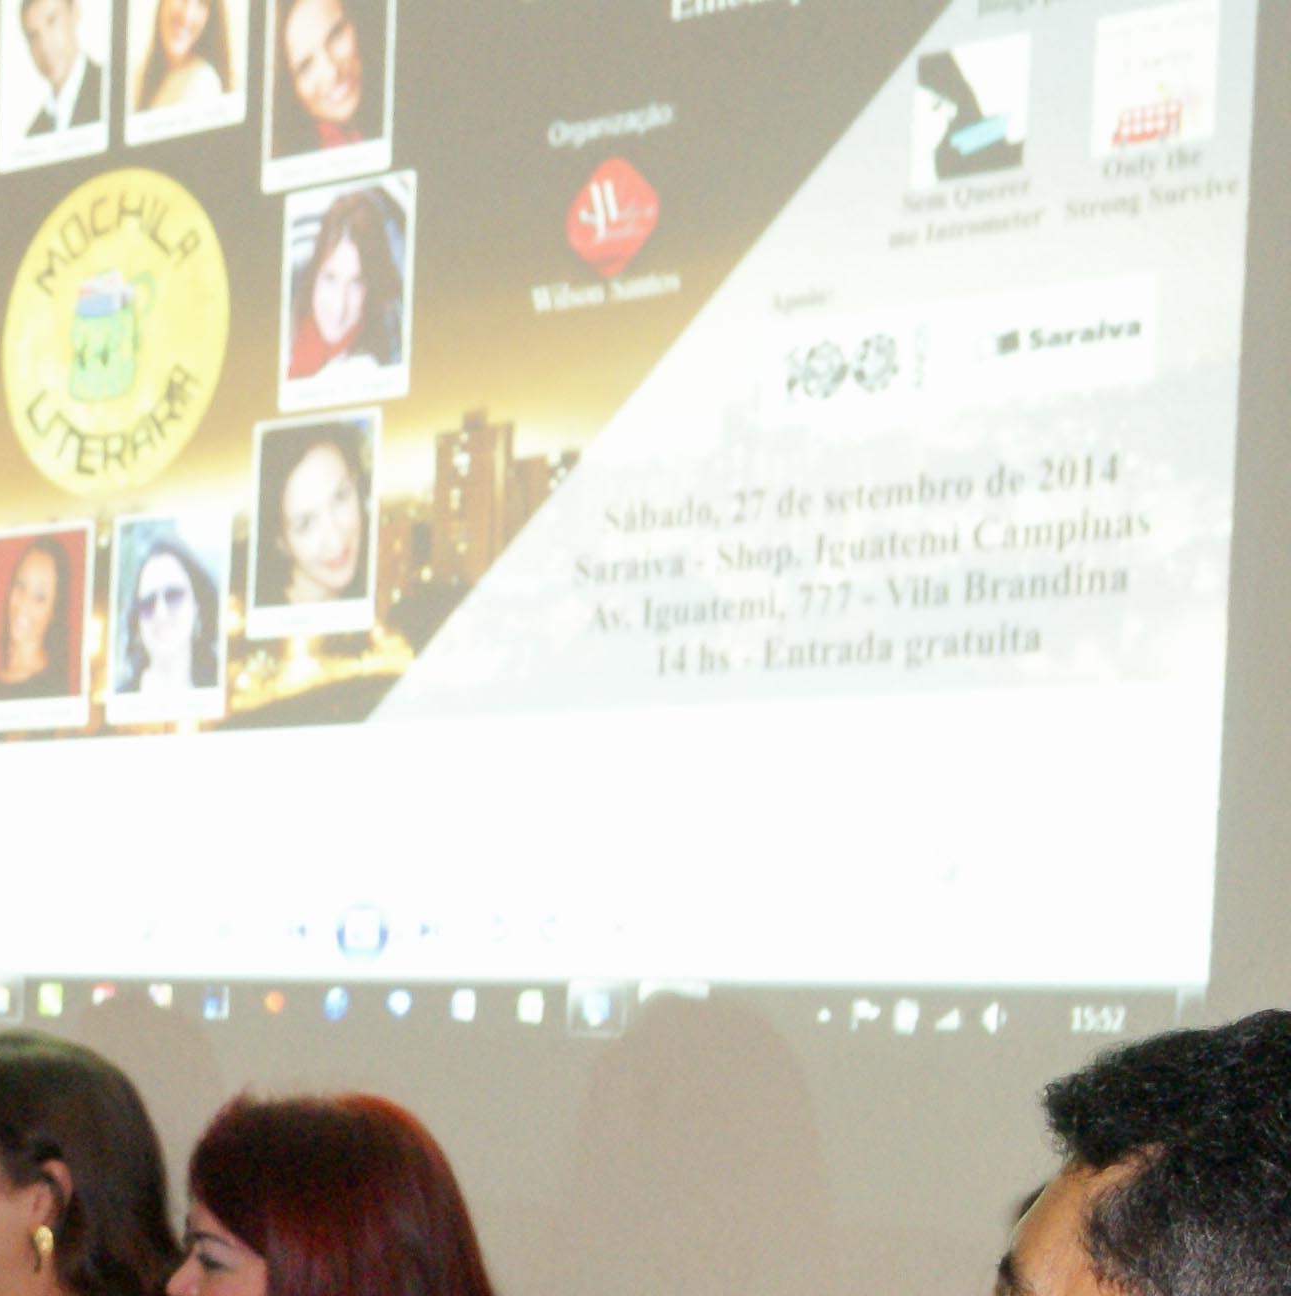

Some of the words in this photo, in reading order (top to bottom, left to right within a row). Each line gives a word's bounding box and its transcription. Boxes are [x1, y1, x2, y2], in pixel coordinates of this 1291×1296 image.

[1102, 154, 1157, 181] Only
[1167, 149, 1204, 171] the
[953, 178, 1031, 210] Querer
[1065, 190, 1142, 220] Strong
[1149, 176, 1239, 208] Survive
[35, 189, 201, 298] MOCHILA
[1029, 316, 1142, 351] Saraiva
[603, 495, 721, 534] Sábado,
[731, 487, 765, 524] 27
[778, 480, 813, 518] de
[824, 470, 973, 515] setembro
[986, 464, 1024, 498] de
[1037, 451, 1119, 492] 2014
[573, 550, 685, 588] Saraiva
[717, 540, 802, 583] Shop.
[814, 525, 960, 568] Iguatemi
[973, 508, 1152, 555] Campinas
[642, 588, 786, 631] Iguatemi,
[799, 583, 853, 617] 777
[885, 573, 950, 612] Vila
[964, 562, 1129, 606] Brandina
[654, 642, 687, 677] 14
[699, 639, 731, 673] hs
[764, 628, 893, 671] Entrada
[904, 620, 1042, 669] gratuita
